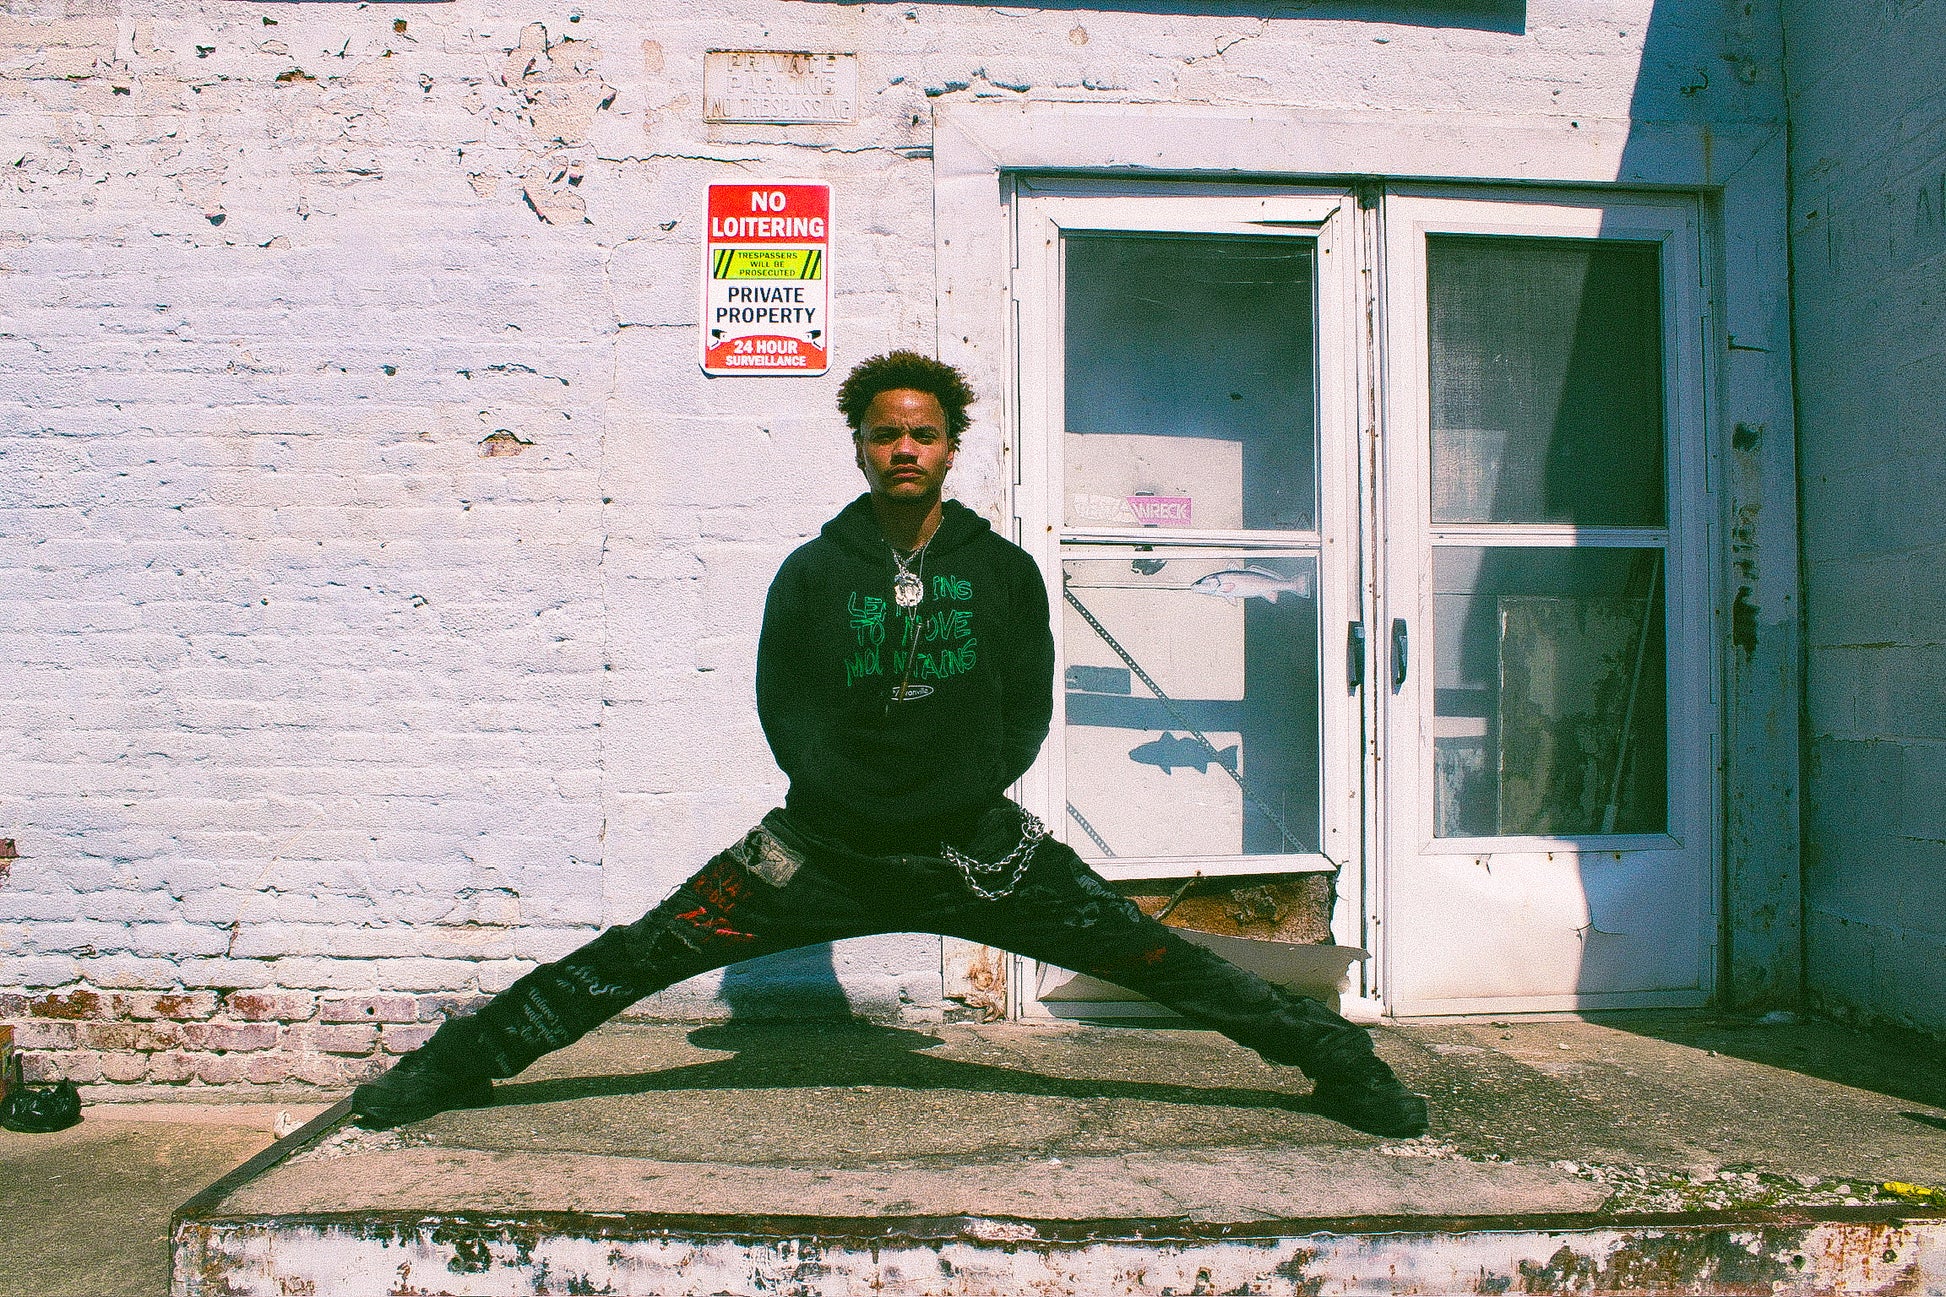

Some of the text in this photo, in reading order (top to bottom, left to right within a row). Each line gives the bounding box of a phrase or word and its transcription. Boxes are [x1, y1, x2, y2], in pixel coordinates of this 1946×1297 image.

[751, 191, 787, 212] NO
[712, 216, 825, 238] LOITERING
[738, 252, 798, 260] TRESPASSERS
[739, 269, 796, 277] PROSECUTED
[728, 287, 805, 303] PRIVATE
[716, 307, 816, 324] PROPERTY
[733, 340, 798, 355] 24 HOUR
[725, 355, 807, 367] SURVEILLANCE
[1131, 502, 1188, 519] WRECK
